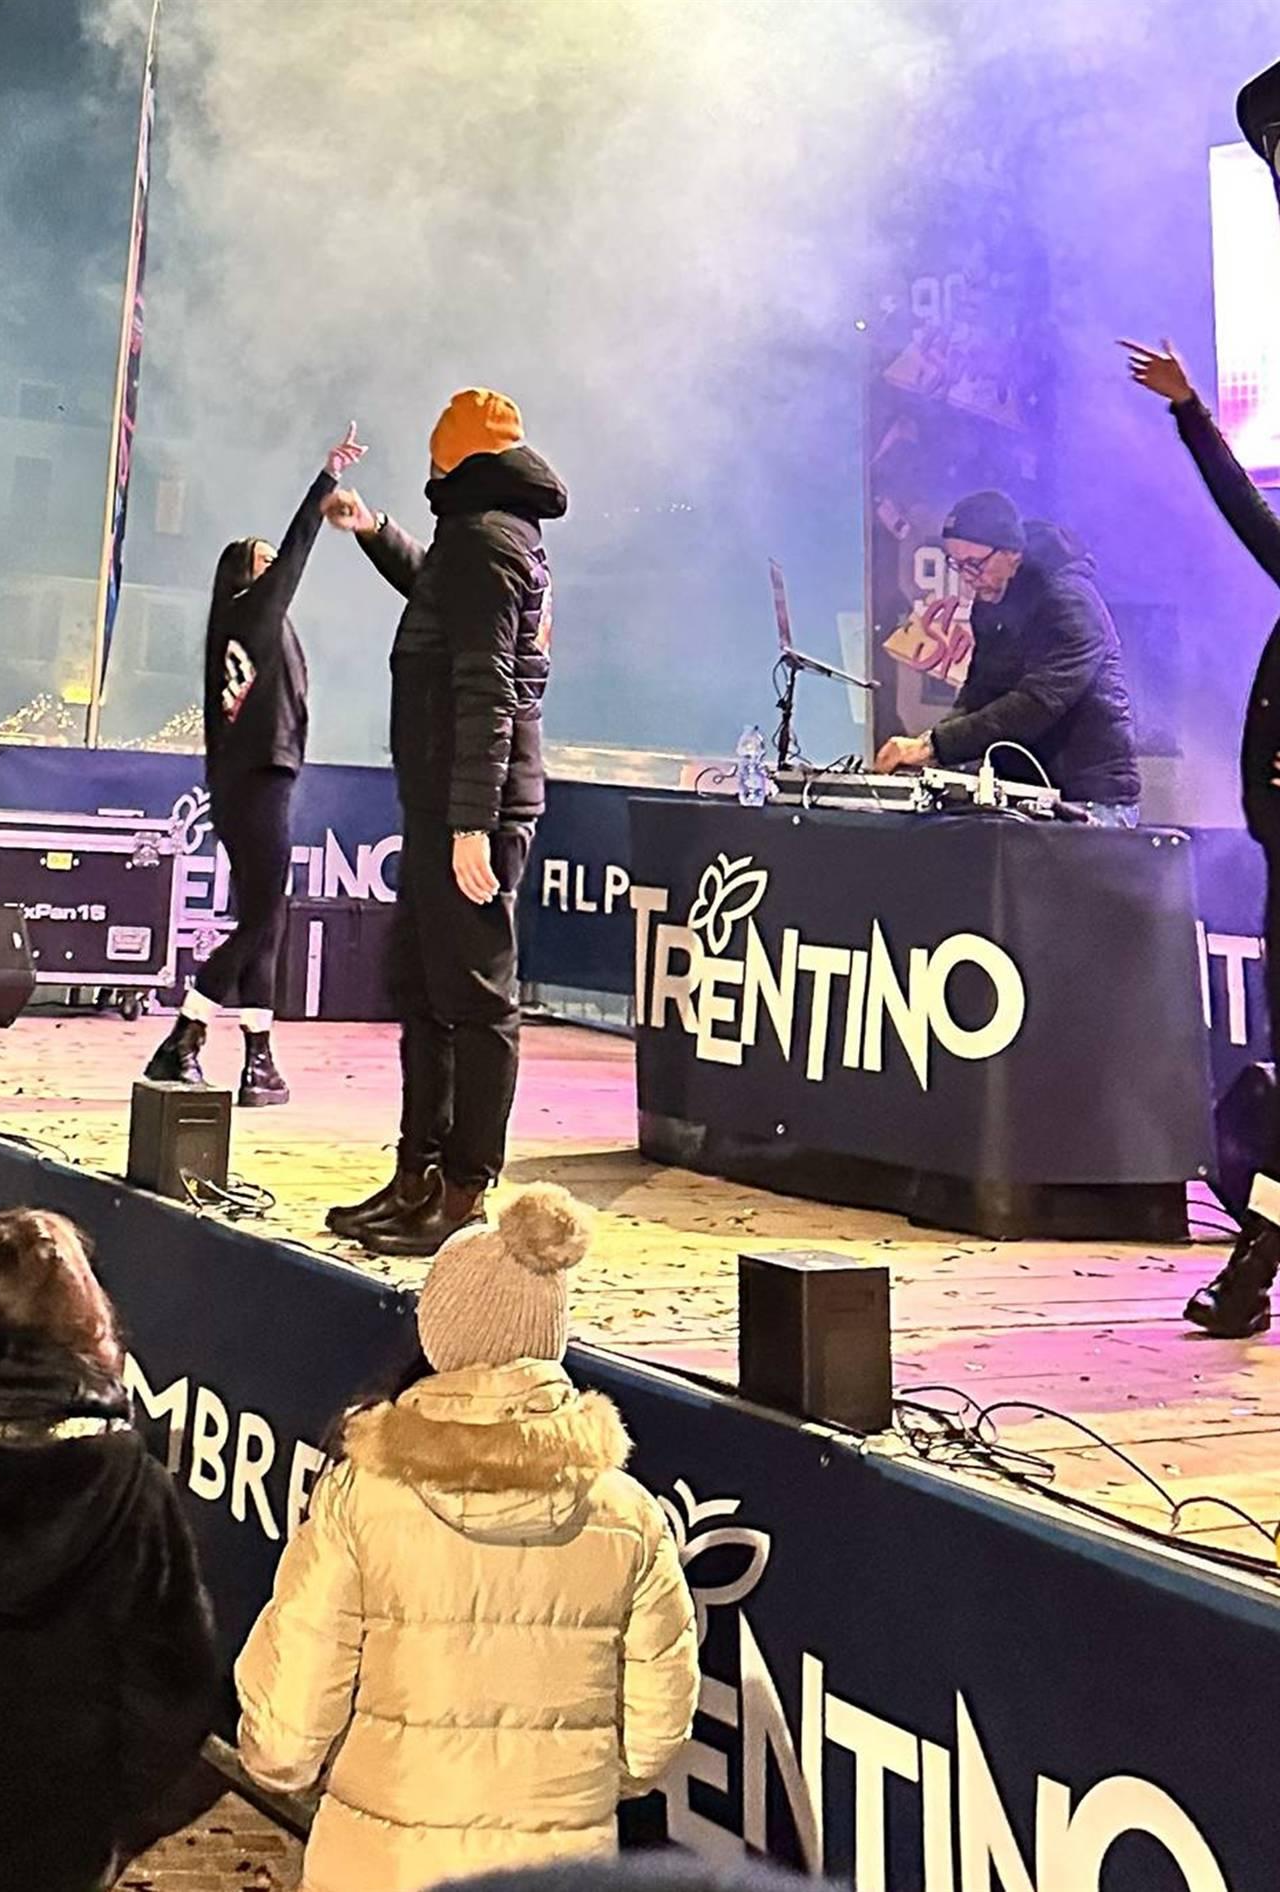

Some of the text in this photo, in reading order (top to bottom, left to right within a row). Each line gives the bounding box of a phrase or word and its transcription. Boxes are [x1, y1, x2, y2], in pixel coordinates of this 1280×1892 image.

[3, 902, 107, 921] xPan16
[541, 858, 631, 914] ALP
[630, 885, 1025, 1092] TRENTINO
[666, 1606, 1232, 1892] ENTINO
